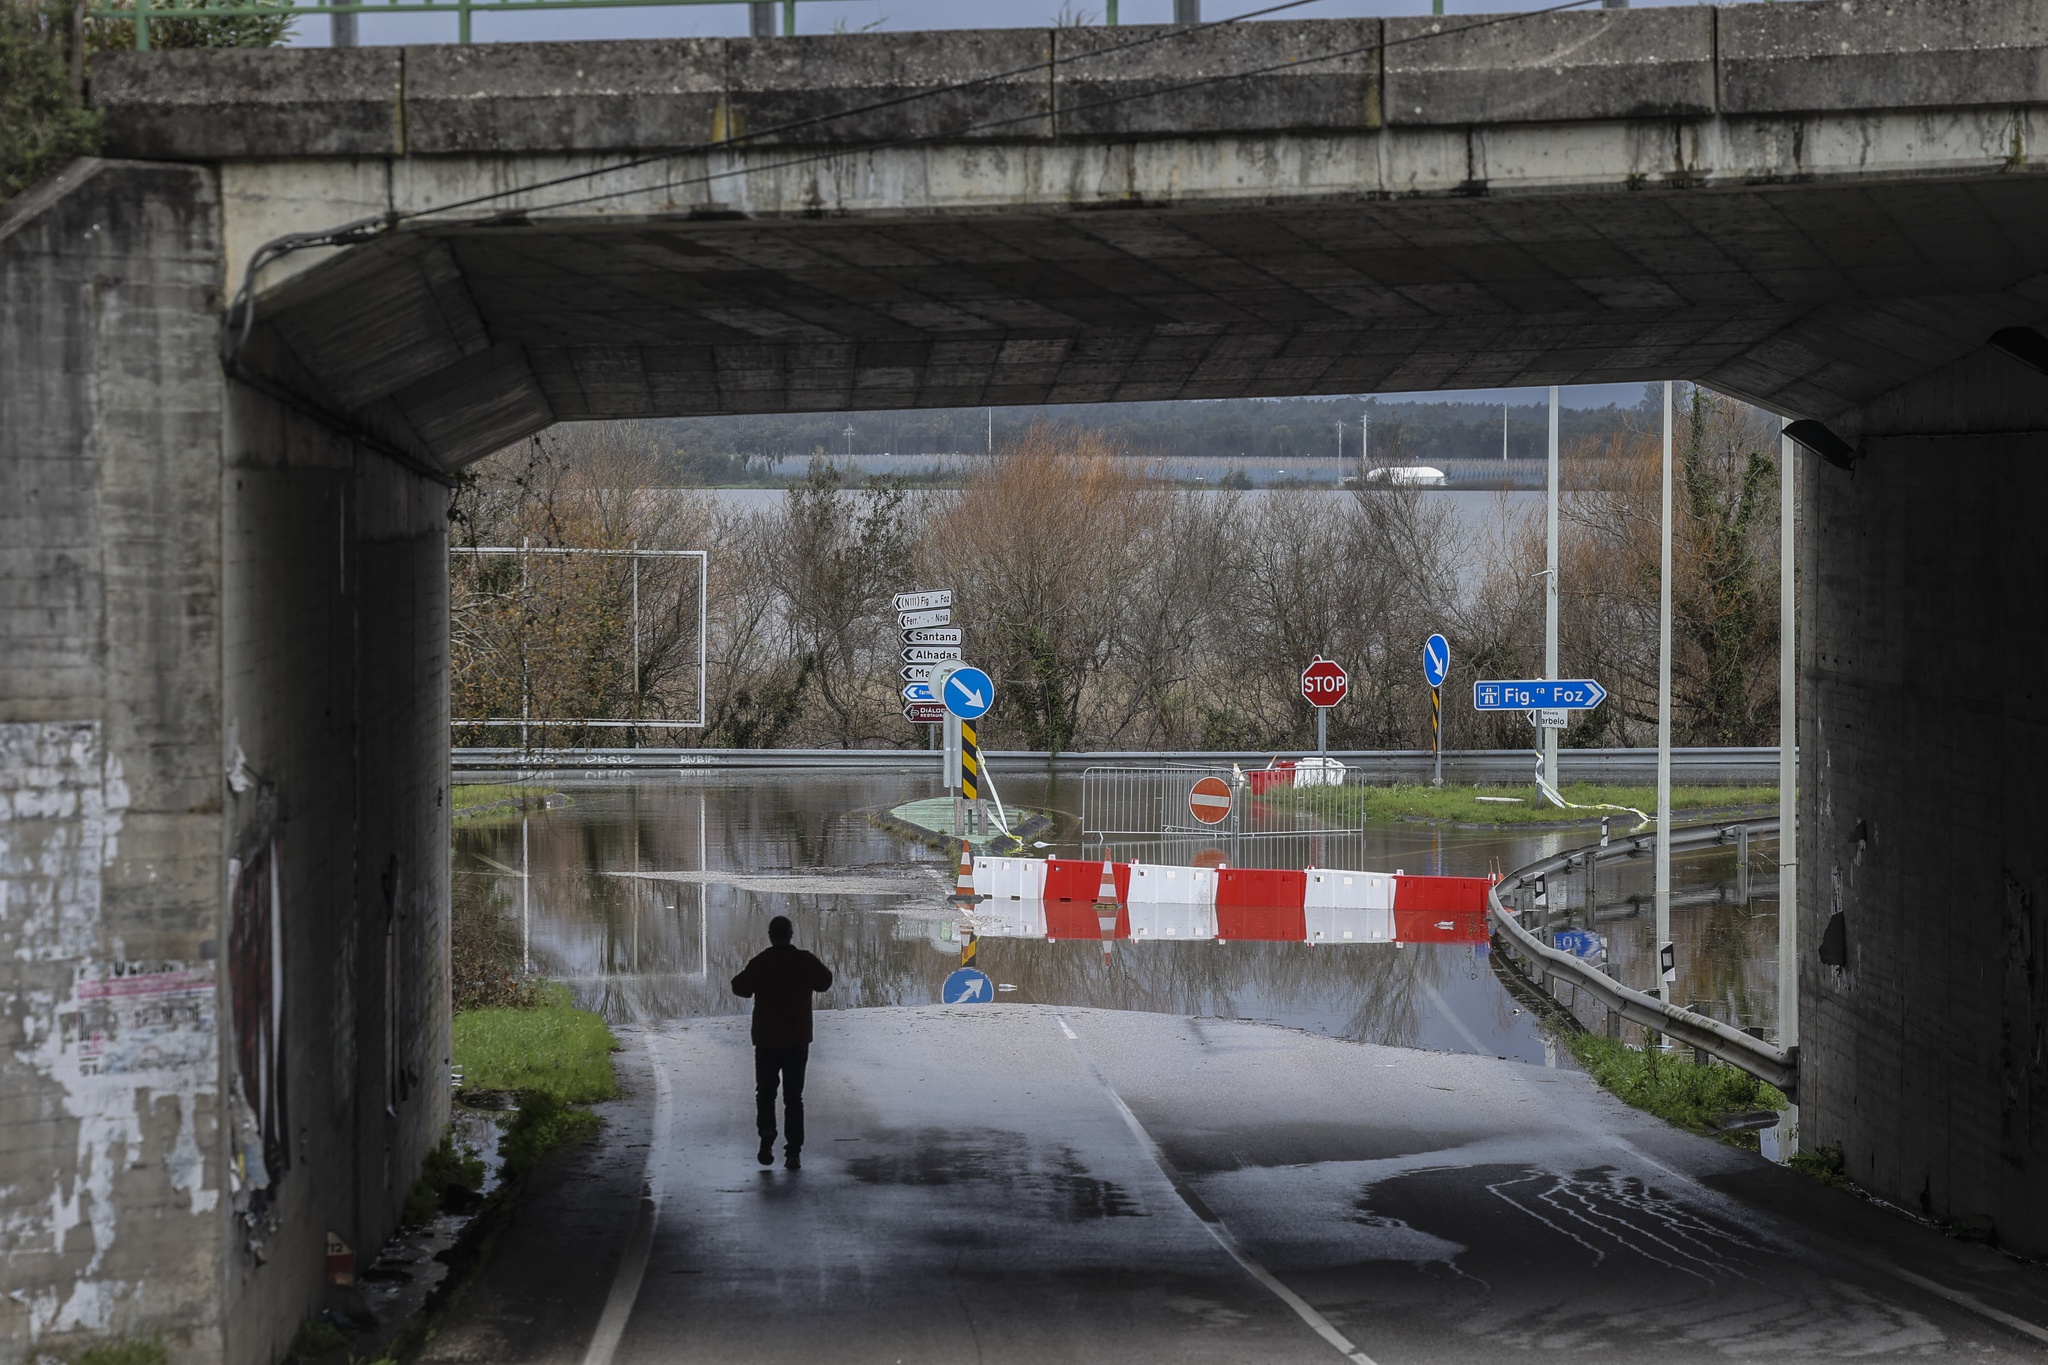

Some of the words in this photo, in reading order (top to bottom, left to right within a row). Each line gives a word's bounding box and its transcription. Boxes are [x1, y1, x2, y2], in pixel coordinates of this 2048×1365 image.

[915, 631, 957, 641] Santana
[915, 650, 957, 659] Alhadas
[915, 669, 930, 678] Ma
[1304, 675, 1345, 693] STOP
[1553, 687, 1584, 702] Foz
[1541, 717, 1564, 725] arbelo
